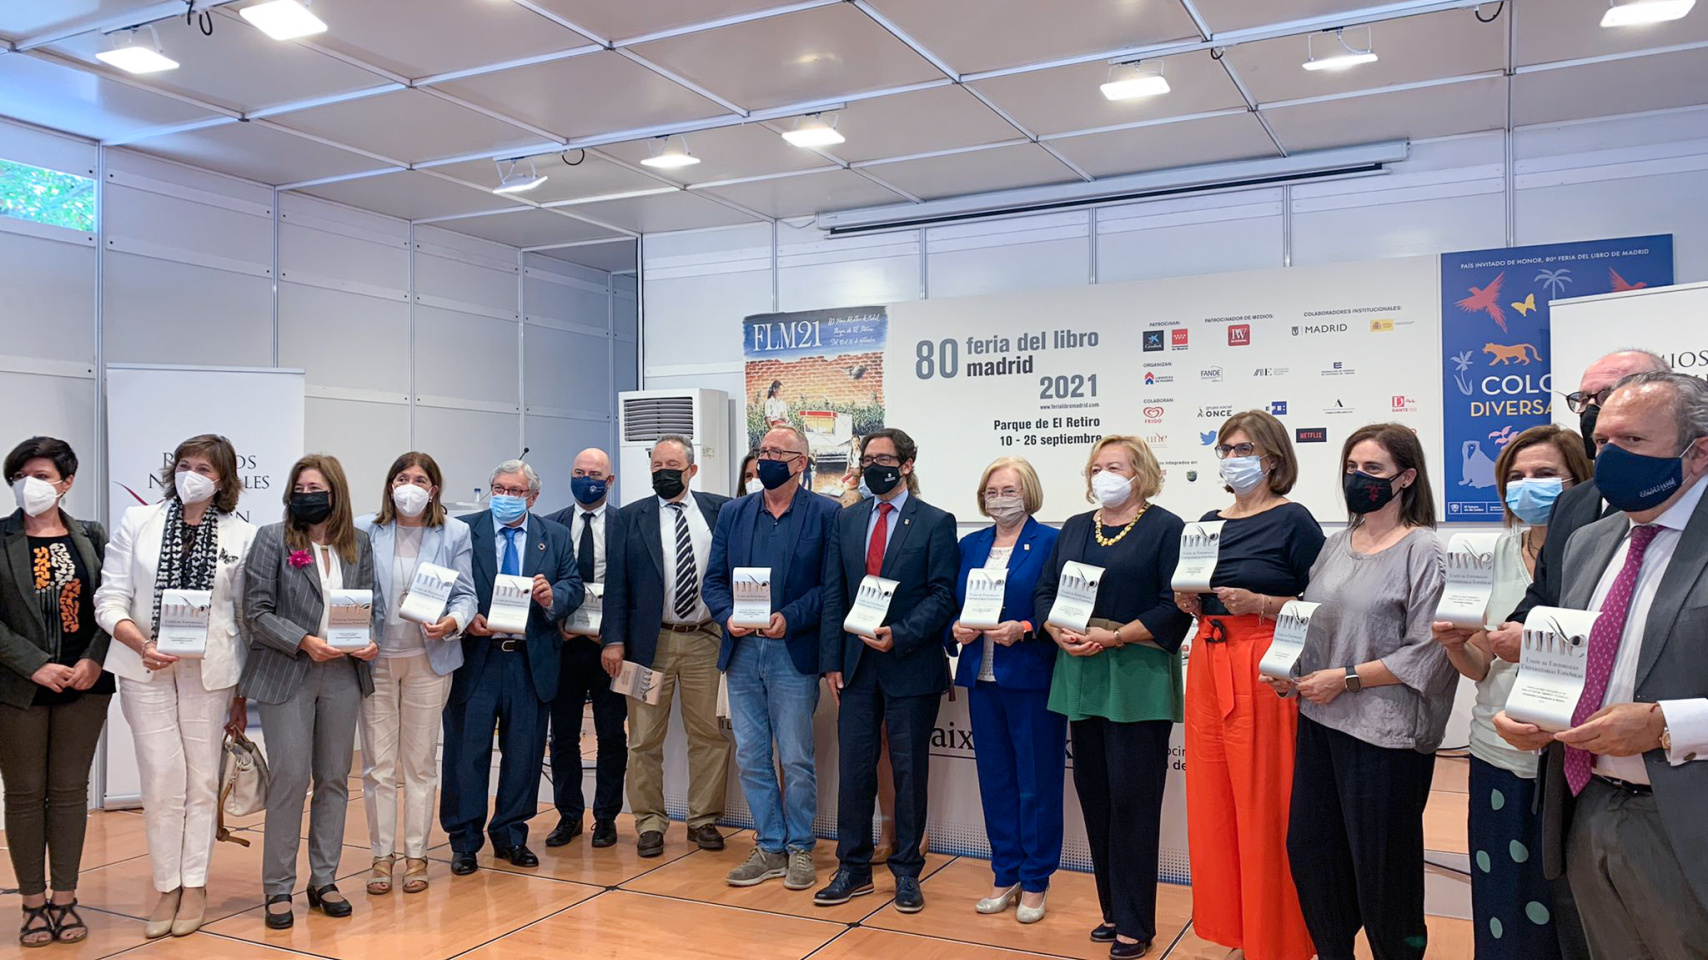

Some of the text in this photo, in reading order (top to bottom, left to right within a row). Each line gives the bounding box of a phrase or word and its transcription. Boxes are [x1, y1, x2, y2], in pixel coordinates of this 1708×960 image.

[753, 320, 822, 352] FLM21
[1305, 323, 1348, 334] MADRID
[966, 329, 1099, 355] feria del libro
[916, 338, 959, 380] 80
[967, 355, 1033, 377] madrid
[1039, 374, 1097, 399] 2021
[1039, 402, 1100, 410] www.ferialibromadrid.com
[994, 416, 1100, 433] Parque de El Retiro
[1000, 435, 1013, 446] 10
[1024, 434, 1037, 445] 26
[1040, 432, 1102, 447] septiembre
